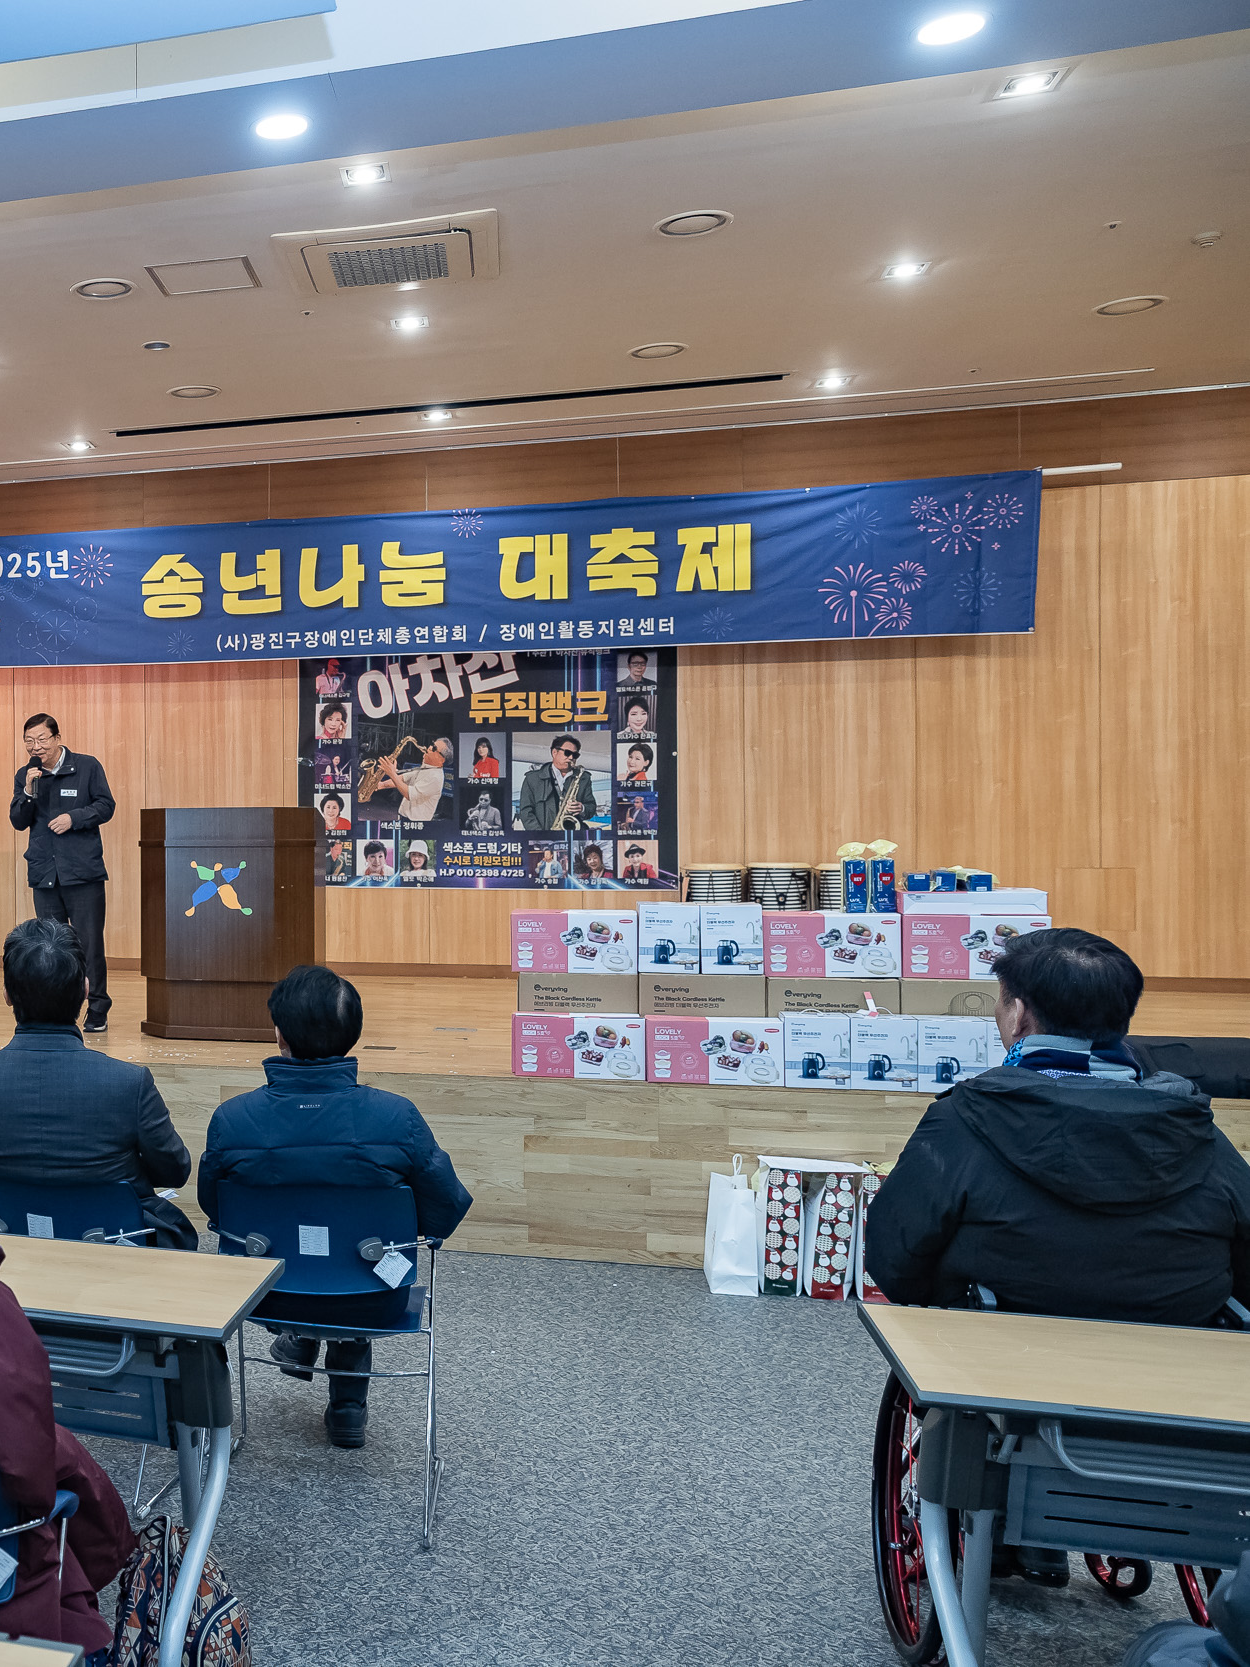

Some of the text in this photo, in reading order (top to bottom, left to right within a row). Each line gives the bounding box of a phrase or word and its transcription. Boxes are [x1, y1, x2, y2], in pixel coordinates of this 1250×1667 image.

[140, 523, 751, 618] 송년나눔 대축제
[216, 624, 467, 652] (사)광진구장애인단체총연합회
[499, 616, 675, 641] 장애인활동지원센터
[357, 652, 520, 719] 아차산
[469, 690, 609, 724] 뮤직뱅크
[380, 821, 401, 830] 색소폰
[443, 842, 522, 855] 색소폰,드럼,기타
[443, 856, 522, 867] 수시로 회원모집!!!
[439, 868, 524, 877] H.P 010 2398 4725
[654, 1027, 682, 1035] LOVELY
